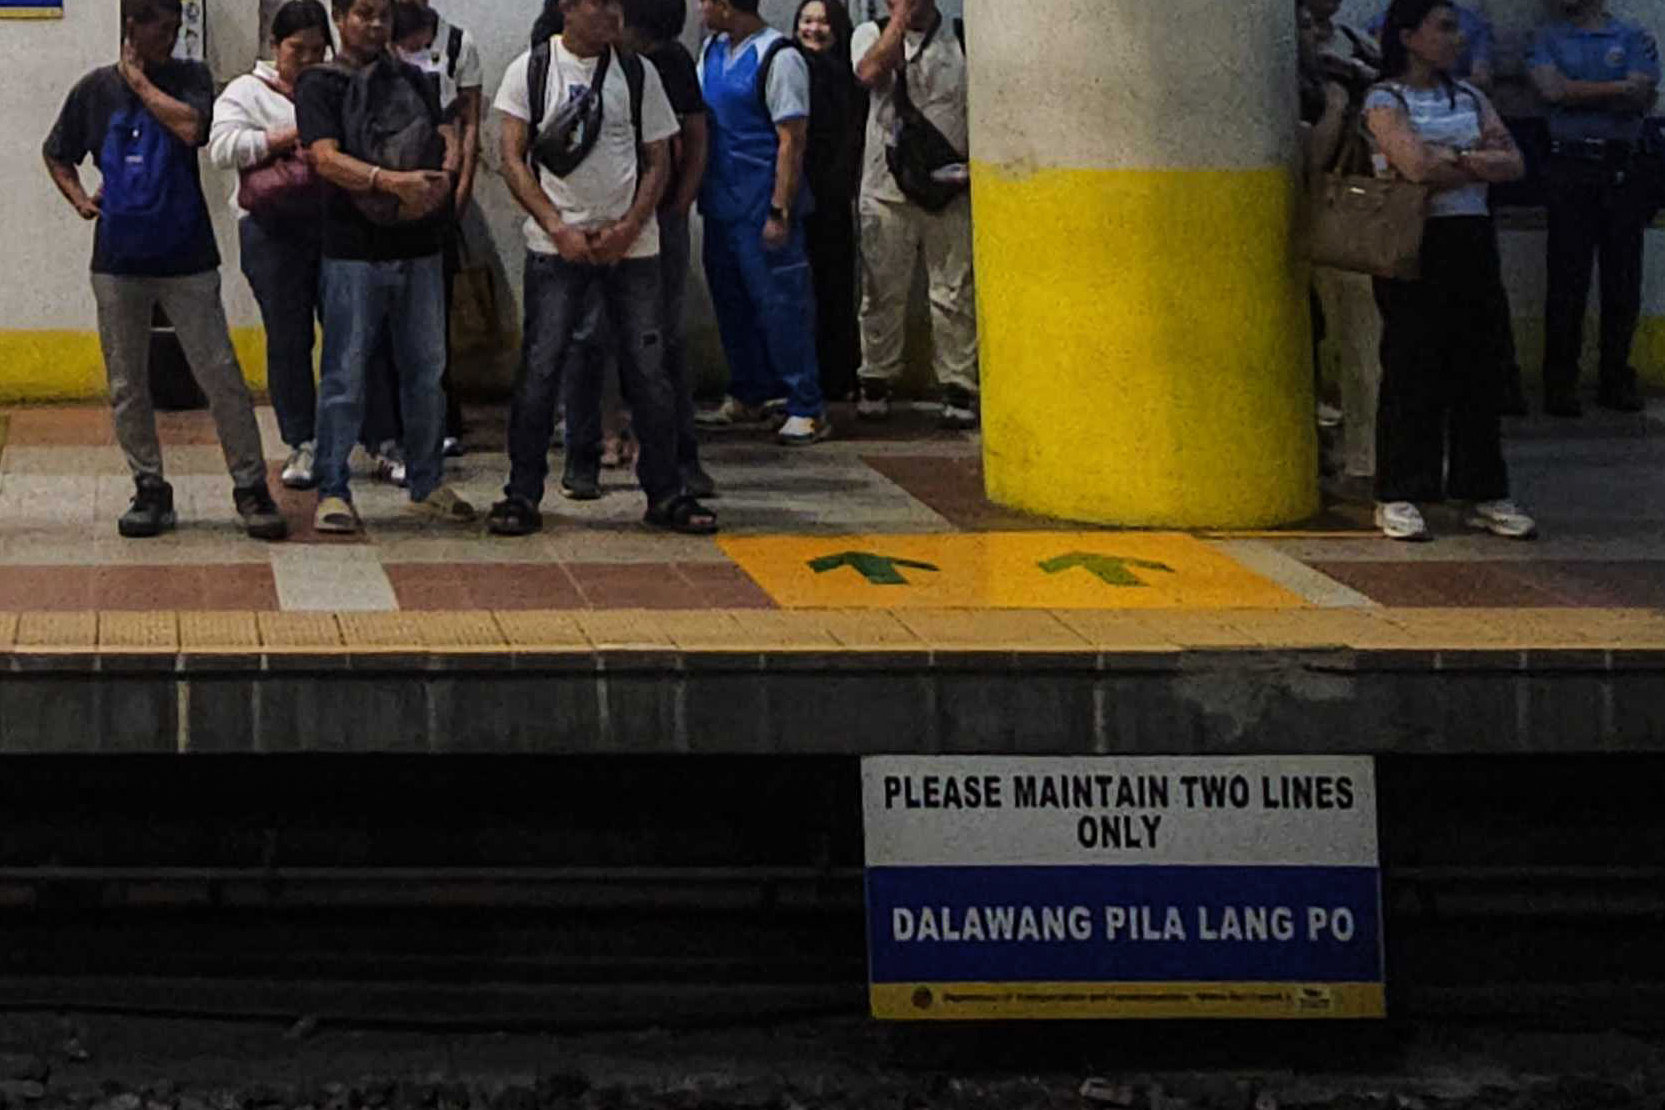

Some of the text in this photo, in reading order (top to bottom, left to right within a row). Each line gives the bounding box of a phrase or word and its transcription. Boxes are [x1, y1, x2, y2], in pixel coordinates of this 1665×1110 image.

[884, 775, 1355, 809] PLEASE MAINTAIN TWO LINES
[1077, 815, 1163, 849] ONLY
[892, 906, 1355, 941] DALAWANG PILA LANG PO
